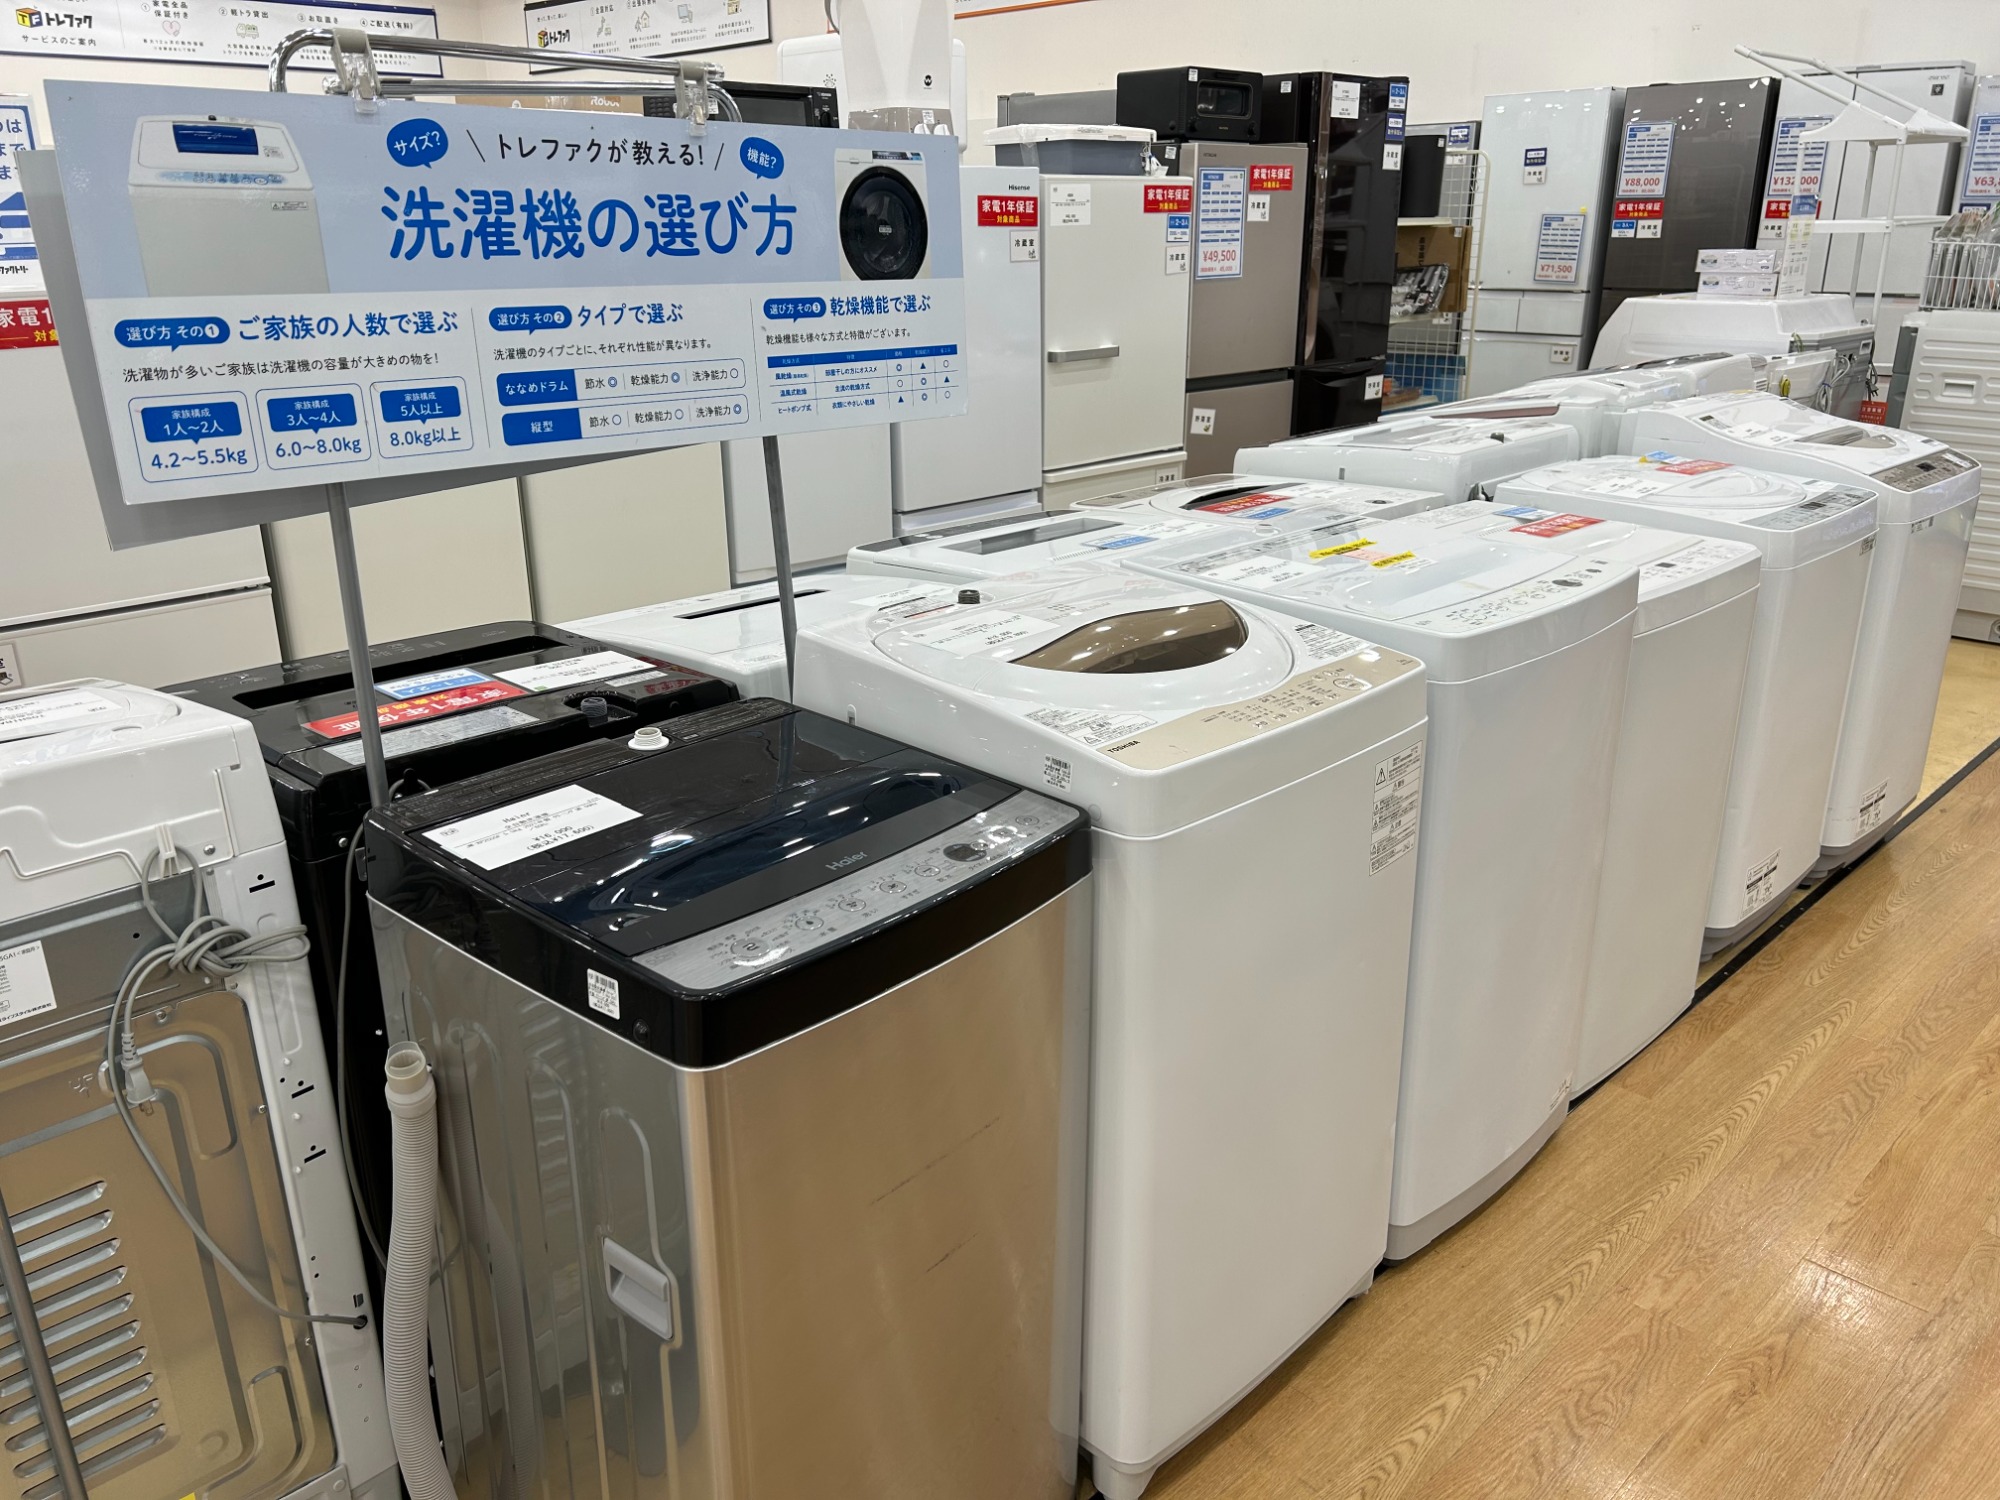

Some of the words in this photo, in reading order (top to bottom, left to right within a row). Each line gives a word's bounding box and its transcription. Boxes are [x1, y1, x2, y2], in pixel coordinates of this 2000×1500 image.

[45, 12, 93, 29] トレファク
[154, 10, 189, 19] 保証付き
[231, 8, 270, 19] 軽トラ貸出
[22, 34, 97, 47] サービスのご案内
[394, 130, 442, 157] サイズ?
[499, 133, 704, 167] トレファクが教える!
[747, 146, 777, 169] 機能?
[1253, 168, 1291, 180] 家電1年保証
[1625, 178, 1660, 188] ¥88,000
[1147, 188, 1190, 201] 家電1年保証
[982, 199, 1035, 213] 家電1年保証
[1618, 202, 1661, 212] 家電1年保証
[381, 184, 797, 261] 洗濯機の選び方
[997, 215, 1020, 223] 対象商品
[1014, 238, 1035, 247] 冷蔵室
[1203, 250, 1237, 263] ¥49,500
[1540, 263, 1573, 274] ¥71,500
[769, 304, 795, 316] 選び方
[830, 294, 932, 317] 乾燥機能で選ぶ
[497, 313, 530, 327] 選び方
[577, 302, 684, 328] タイプで選ぶ
[126, 326, 171, 341] 選び方
[238, 310, 458, 342] ご家族の人数で選ぶ
[766, 328, 912, 346] 乾燥機能も様々な方式と特徴がございます。
[493, 338, 712, 362] 洗濯機のタイプごとに、それぞれ性能が異なります。
[122, 352, 440, 384] 洗濯物が多いご家族は洗濯機の容量が大きめの物を!
[505, 380, 570, 395] ななめドラム
[585, 377, 606, 389] 節水
[630, 374, 669, 386] 乾燥能力
[692, 369, 728, 382] 洗浄能力
[835, 382, 871, 393] 主流の乾燥方式
[404, 391, 438, 401] 家族構成
[294, 399, 331, 410] 家族構成
[400, 403, 444, 417] 5人以上
[778, 405, 813, 415] ヒートポンプ式
[171, 407, 212, 419] 家族構成
[530, 421, 554, 433] 縦型
[589, 415, 610, 428] 節水
[634, 411, 673, 424] 乾燥能力
[695, 405, 731, 418] 洗浄能力
[389, 426, 461, 448] 8.0kg以上
[1107, 739, 1141, 754] TOSHIBA
[502, 811, 531, 824] Haier
[825, 850, 869, 872] Haier
